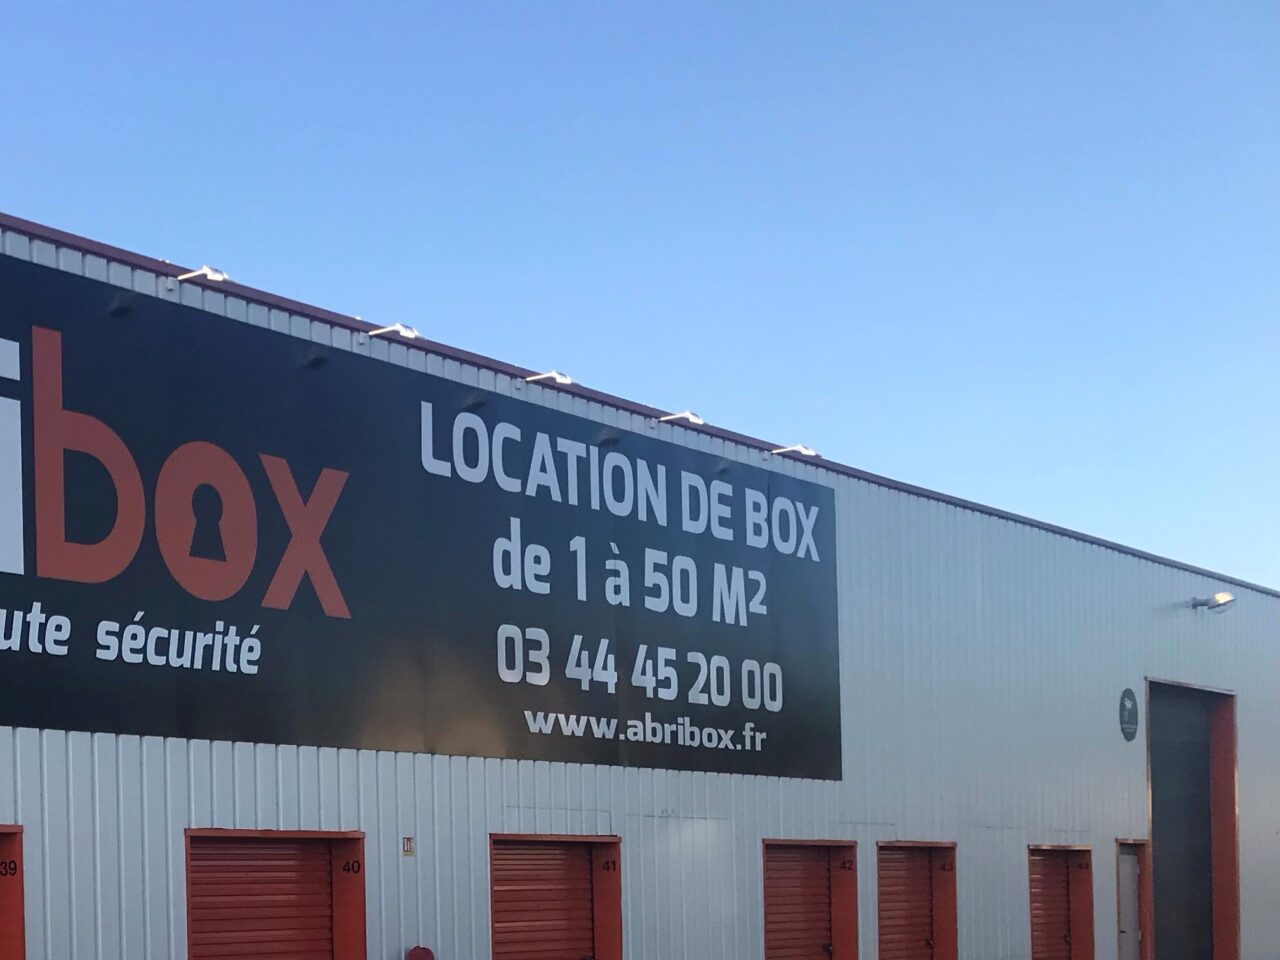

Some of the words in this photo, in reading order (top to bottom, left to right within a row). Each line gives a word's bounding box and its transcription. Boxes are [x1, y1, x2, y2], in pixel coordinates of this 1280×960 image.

[420, 400, 667, 527] LOCATION
[680, 470, 734, 541] DE
[745, 488, 821, 562] BOX
[492, 517, 551, 594] de
[569, 535, 587, 602] 1
[605, 542, 630, 607] à
[644, 547, 698, 618] 50
[96, 610, 262, 675] sécurité
[497, 624, 550, 686] 03
[564, 634, 618, 694] 44
[631, 644, 679, 701] 45
[687, 651, 731, 707] 20
[741, 659, 783, 712] 00
[523, 709, 767, 751] www.abribox.fr
[0, 860, 17, 877] 39
[342, 860, 361, 874] 40
[602, 860, 616, 872] 41
